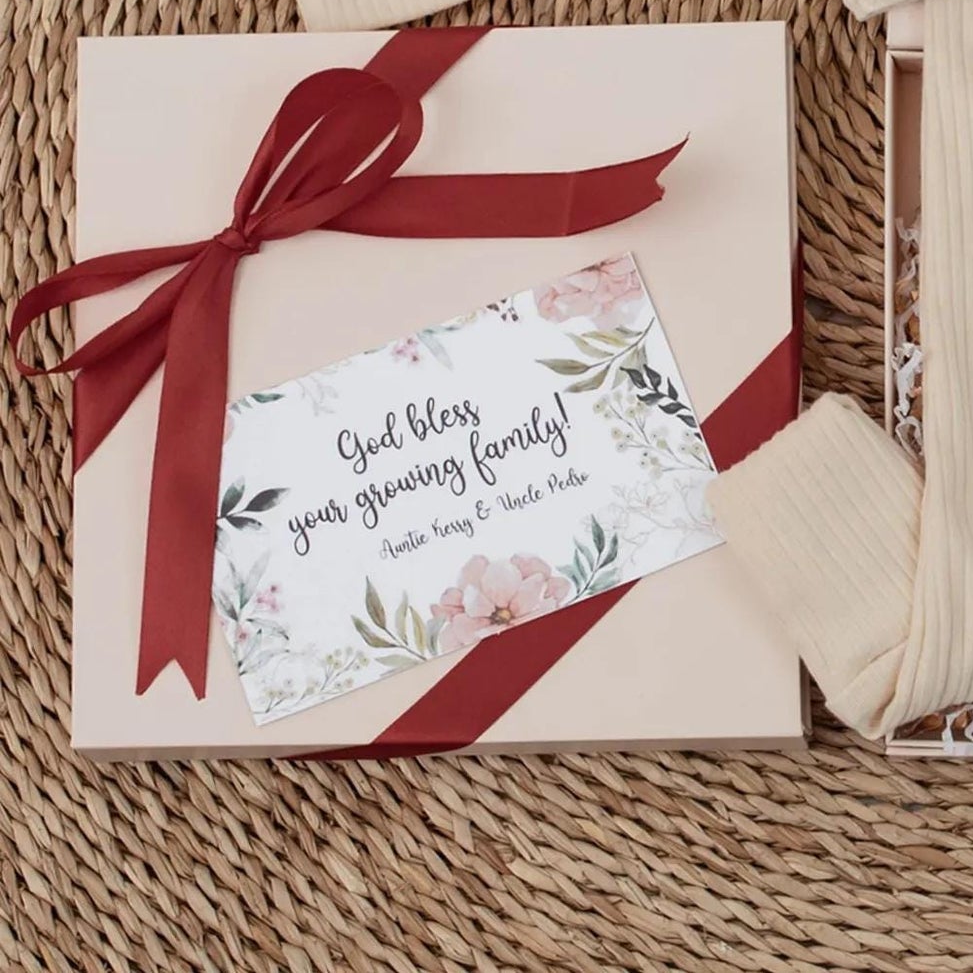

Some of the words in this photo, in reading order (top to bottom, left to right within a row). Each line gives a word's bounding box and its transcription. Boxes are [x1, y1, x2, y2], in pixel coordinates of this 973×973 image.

[288, 499, 348, 556] your
[355, 455, 464, 529] growing
[470, 392, 572, 486] family!
[337, 411, 403, 475] God
[406, 397, 481, 441] bless
[379, 529, 430, 560] Auntie
[431, 517, 475, 538] Kerry
[475, 500, 491, 521] &
[496, 484, 545, 512] Uncle
[546, 467, 591, 494] Pedro
